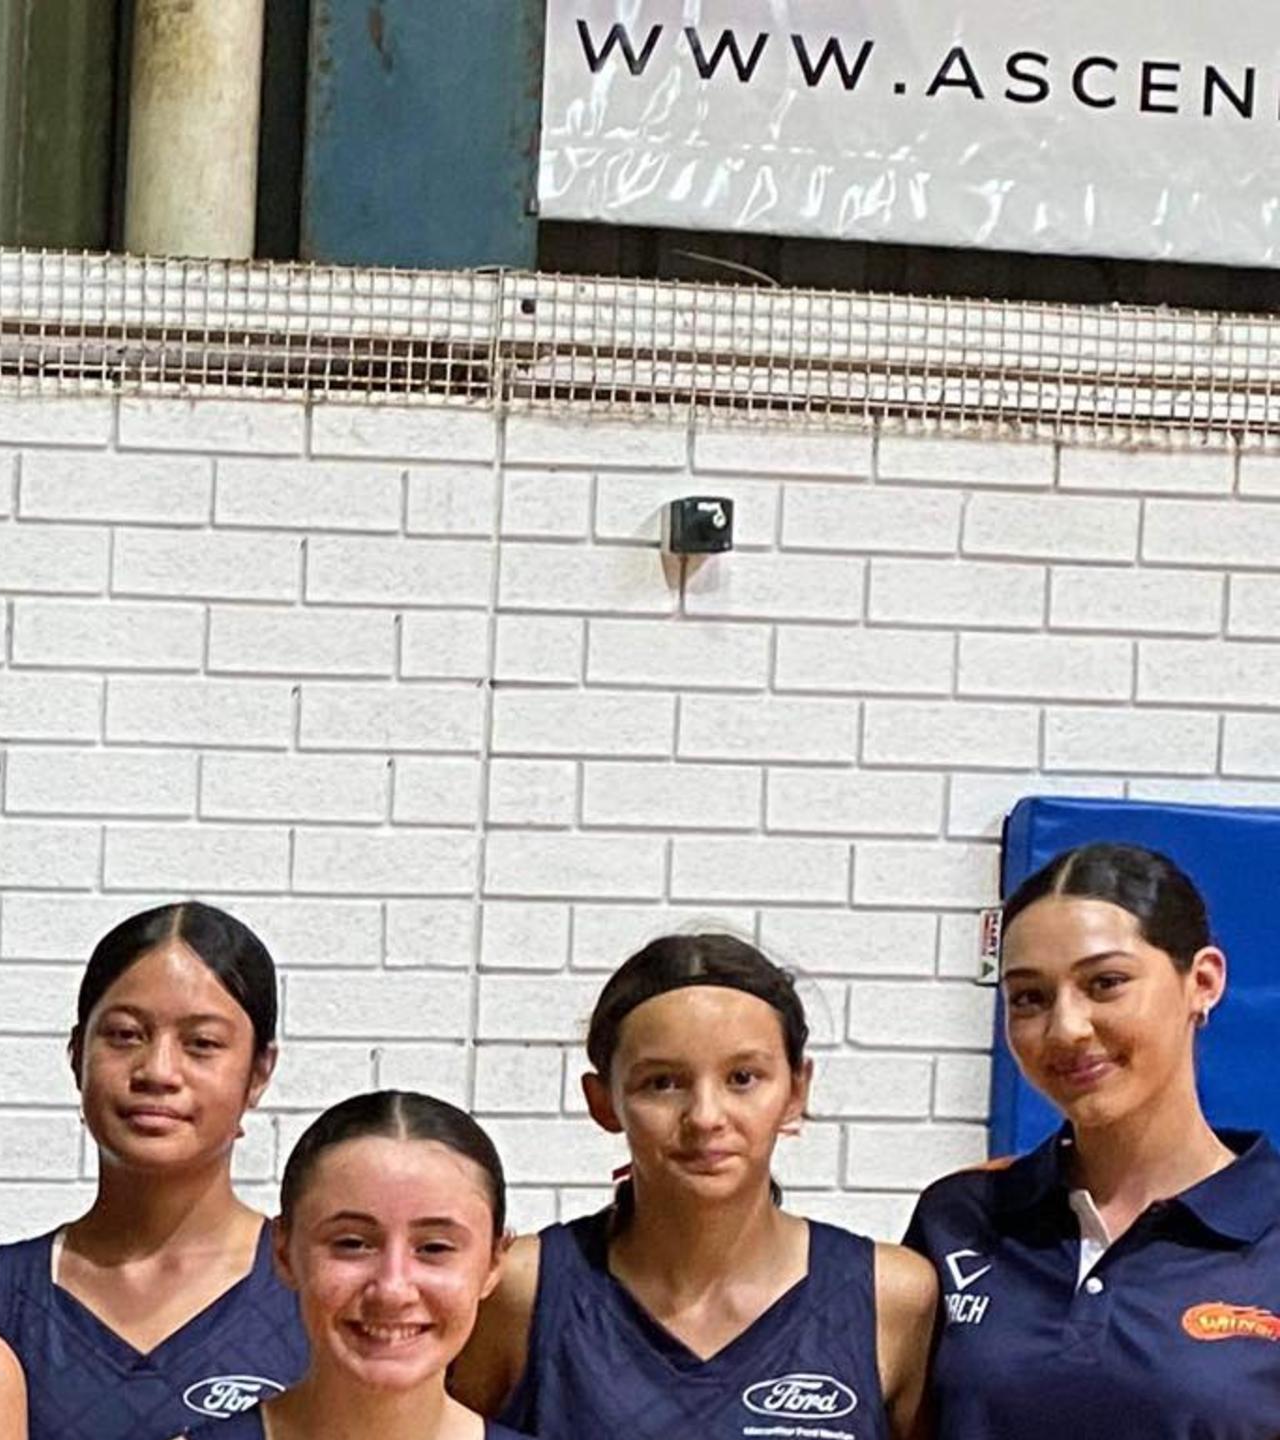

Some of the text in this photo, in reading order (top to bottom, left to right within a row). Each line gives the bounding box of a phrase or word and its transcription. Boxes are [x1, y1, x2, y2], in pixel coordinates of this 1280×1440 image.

[576, 20, 1280, 120] WWW.ASCEN
[944, 1292, 990, 1325] ACH
[763, 1379, 839, 1412] Ford
